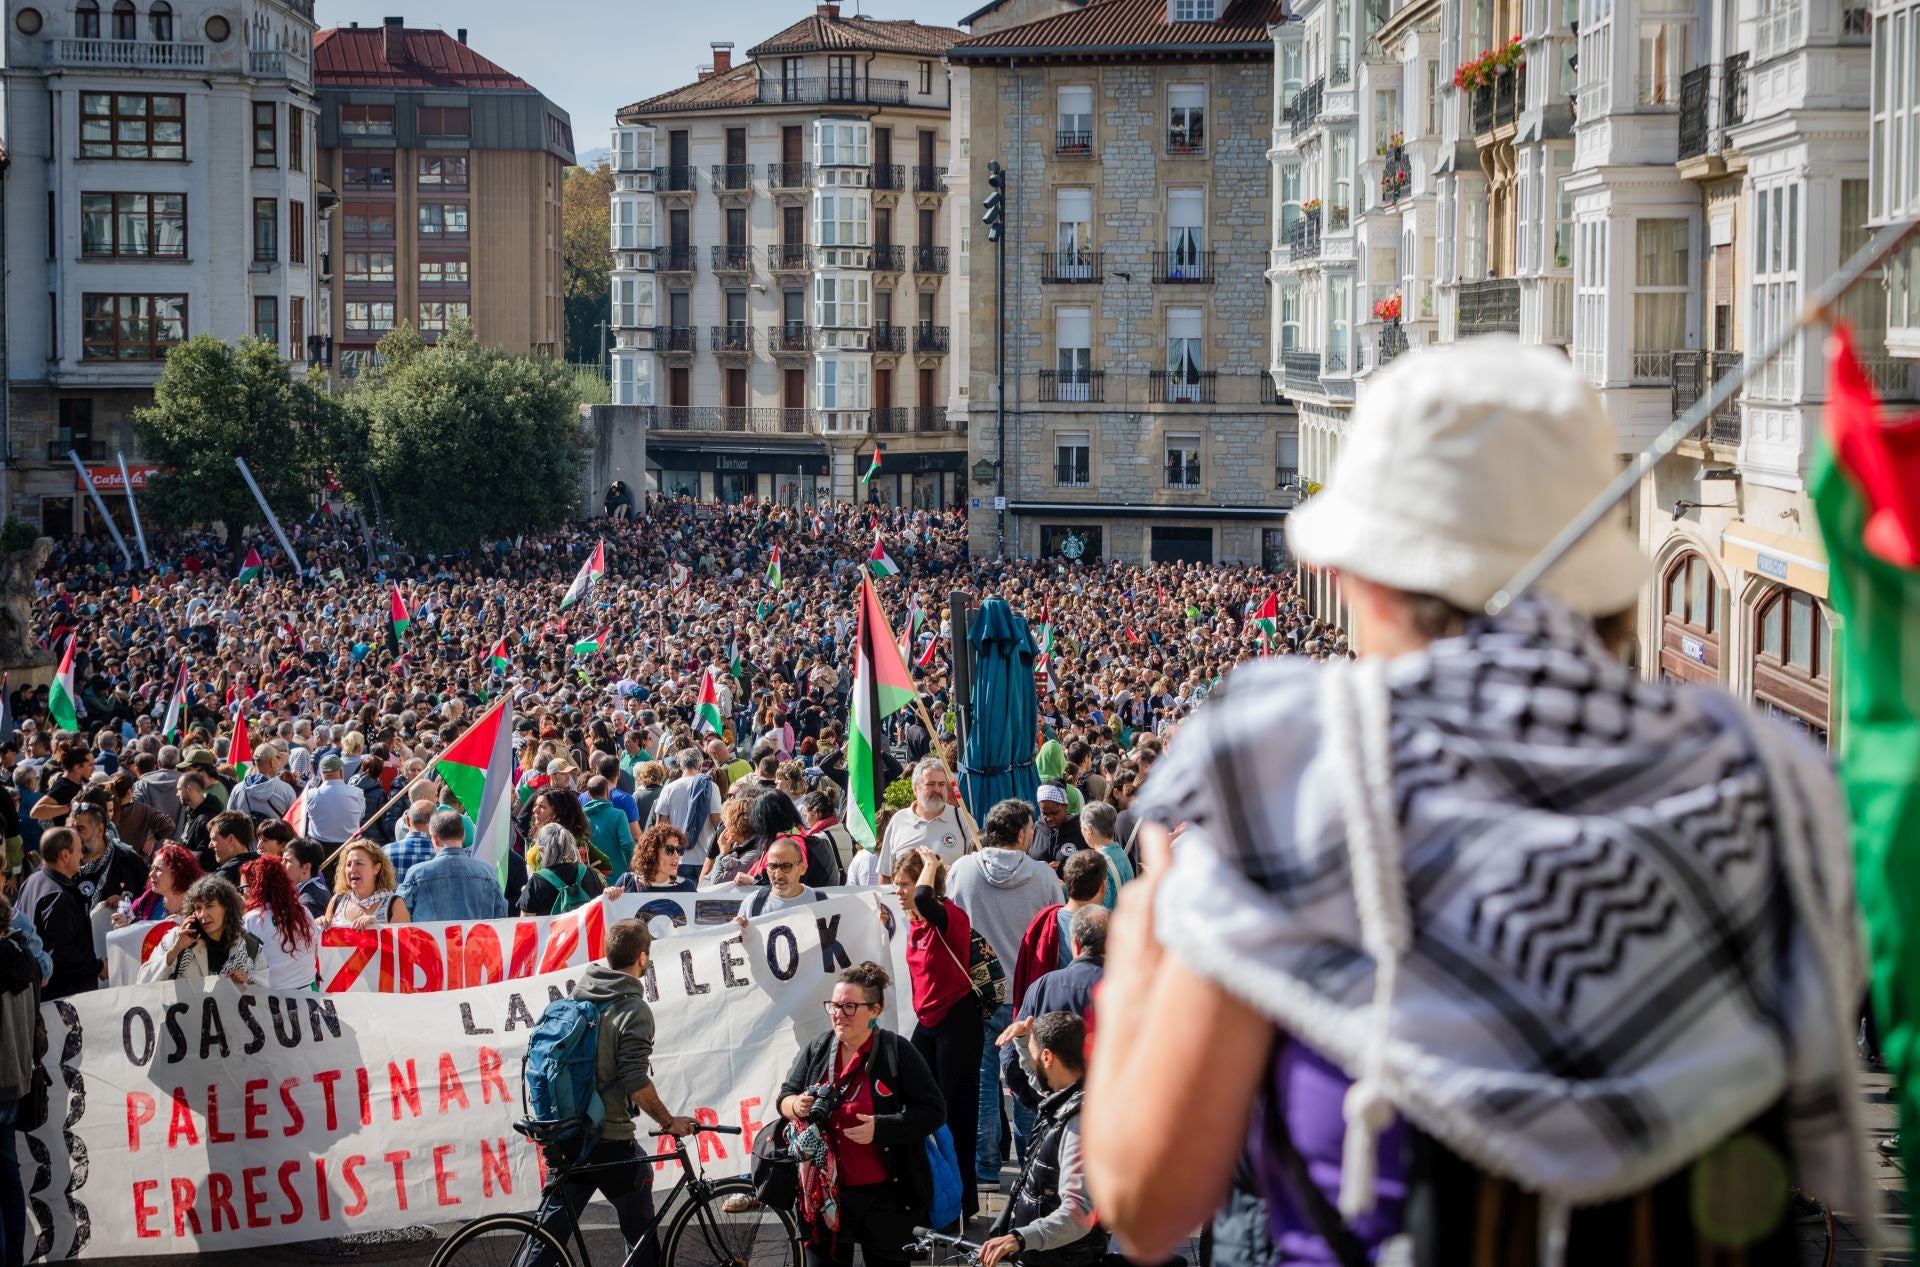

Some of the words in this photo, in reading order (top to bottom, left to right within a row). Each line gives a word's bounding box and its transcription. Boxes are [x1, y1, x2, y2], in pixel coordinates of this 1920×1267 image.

[123, 995, 342, 1066] OSASUN
[459, 914, 852, 1036] LAILEOK
[126, 1047, 514, 1152] PALESTINAR
